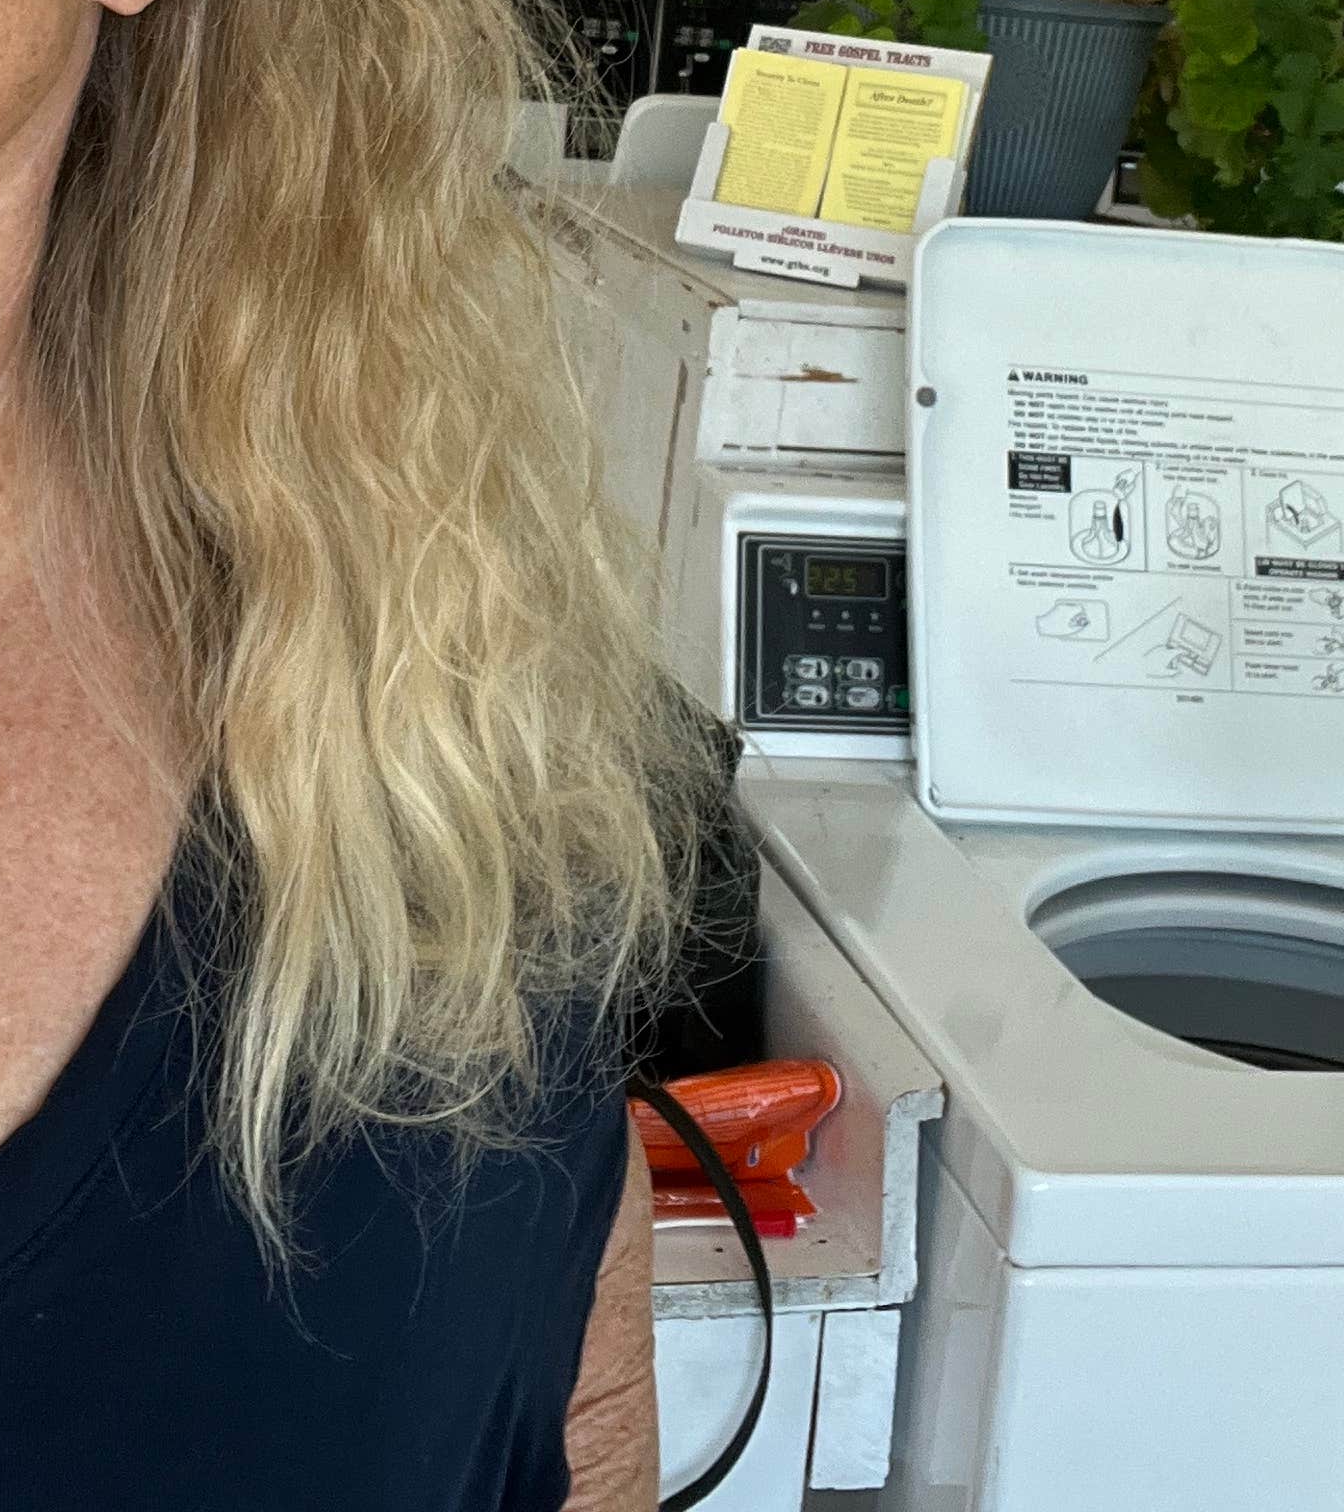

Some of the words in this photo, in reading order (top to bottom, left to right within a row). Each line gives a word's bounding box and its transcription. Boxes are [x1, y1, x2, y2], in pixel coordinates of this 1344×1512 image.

[804, 41, 836, 57] FREE
[838, 45, 882, 63] GOSPEL
[886, 50, 933, 68] TRACTS
[1022, 370, 1089, 386] WARNING
